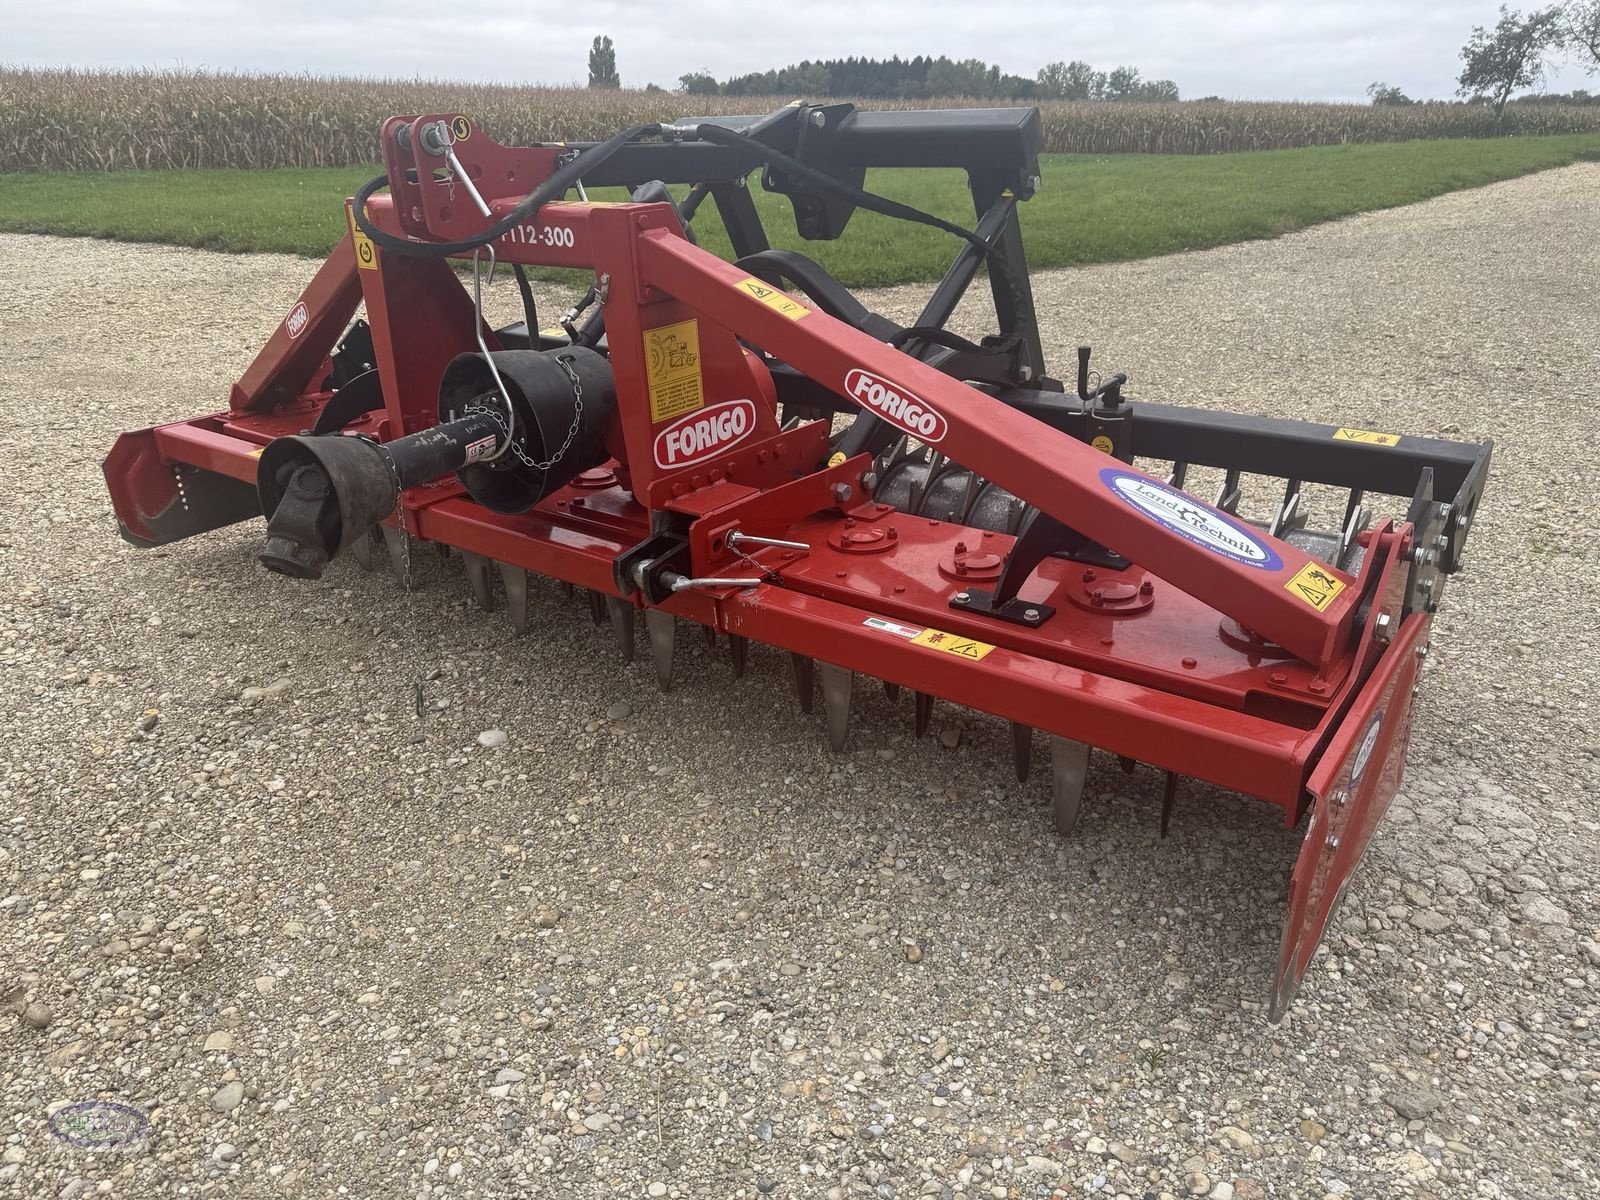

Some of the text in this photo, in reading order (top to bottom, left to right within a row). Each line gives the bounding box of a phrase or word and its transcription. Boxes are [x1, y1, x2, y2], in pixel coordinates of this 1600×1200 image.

[287, 305, 307, 337] FORIGO
[853, 374, 937, 435] FORIGO
[665, 406, 747, 463] FORIGO
[1136, 485, 1179, 511] Land
[1191, 516, 1256, 557] Technik
